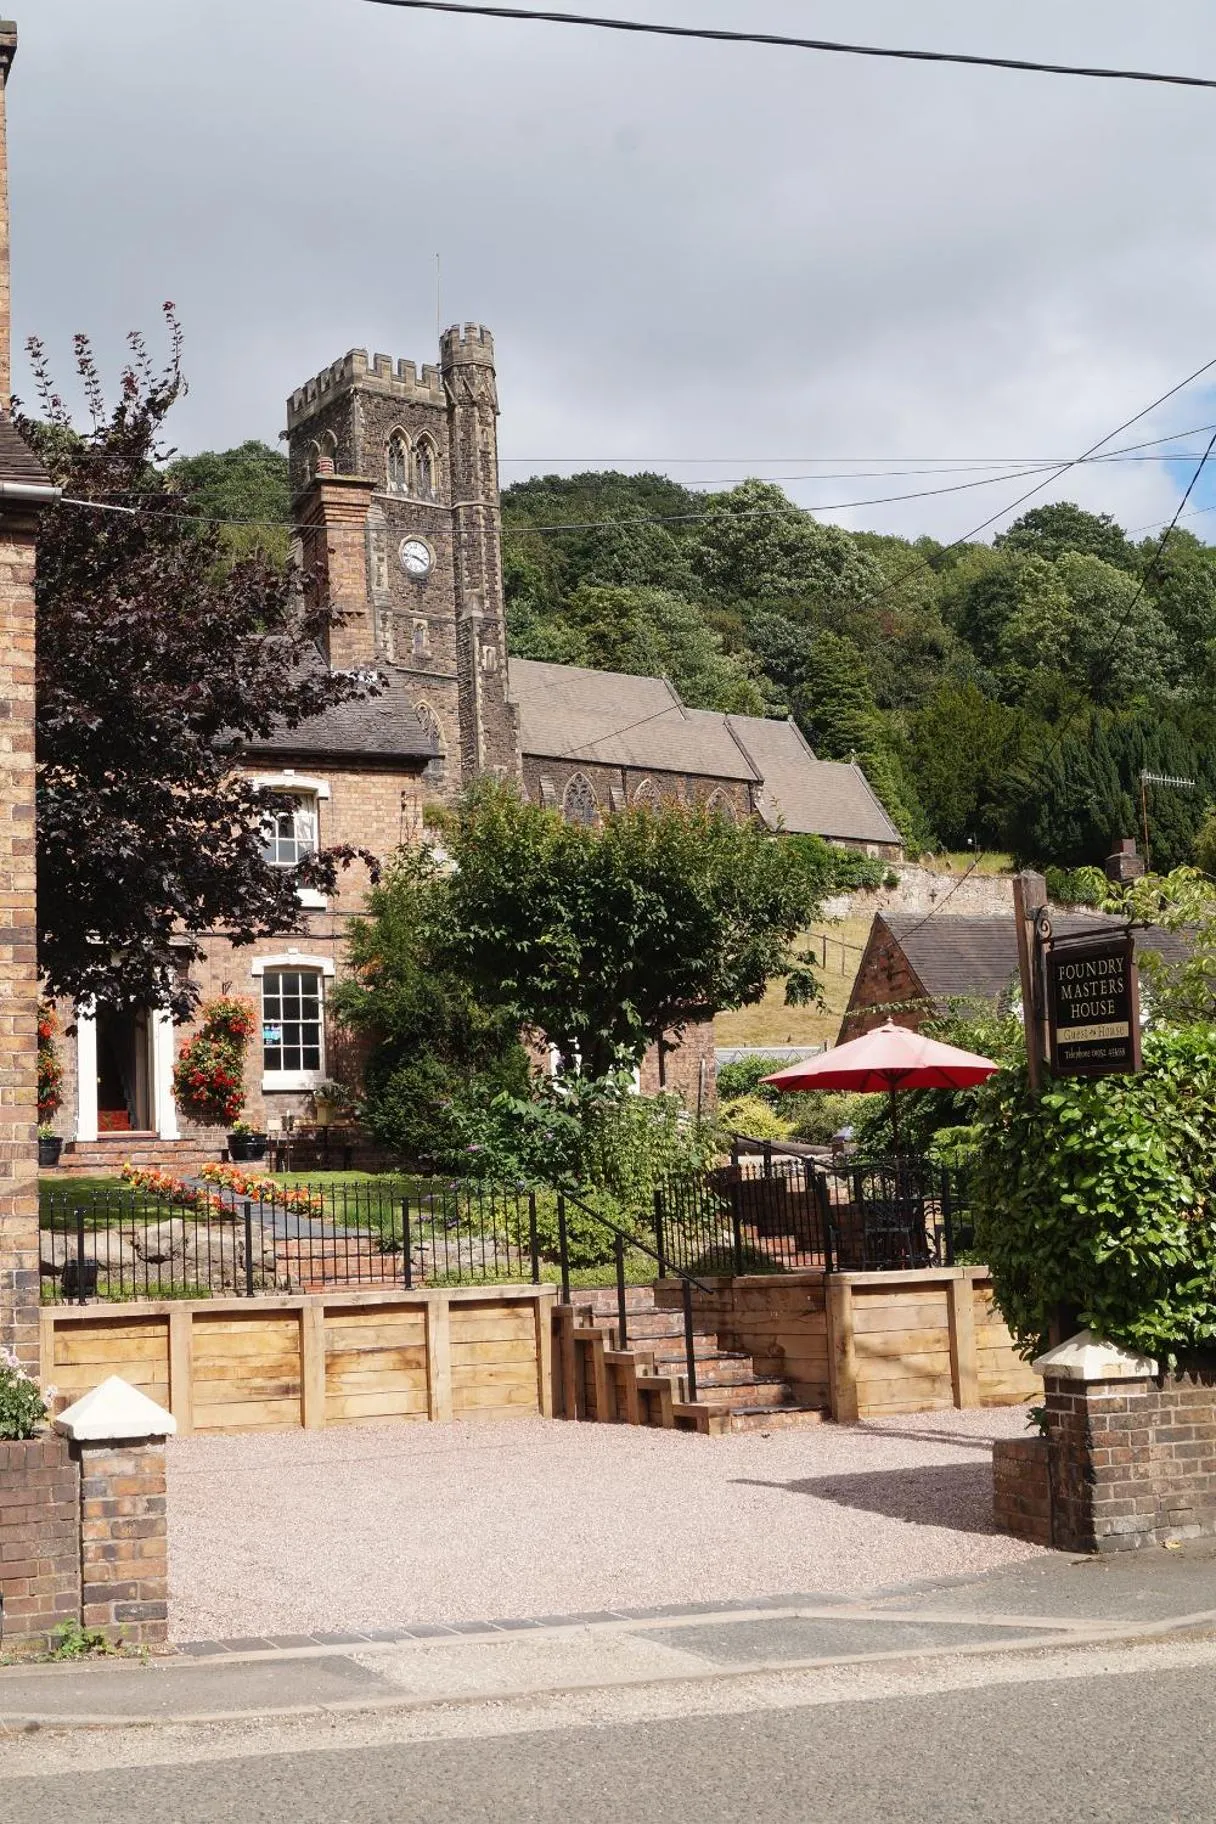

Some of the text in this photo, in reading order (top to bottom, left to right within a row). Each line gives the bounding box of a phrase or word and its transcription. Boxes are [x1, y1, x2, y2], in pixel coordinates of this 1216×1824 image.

[1058, 957, 1124, 981] FOUNDRY
[1060, 977, 1125, 1000] MASTERS
[1070, 999, 1116, 1019] HOUSE
